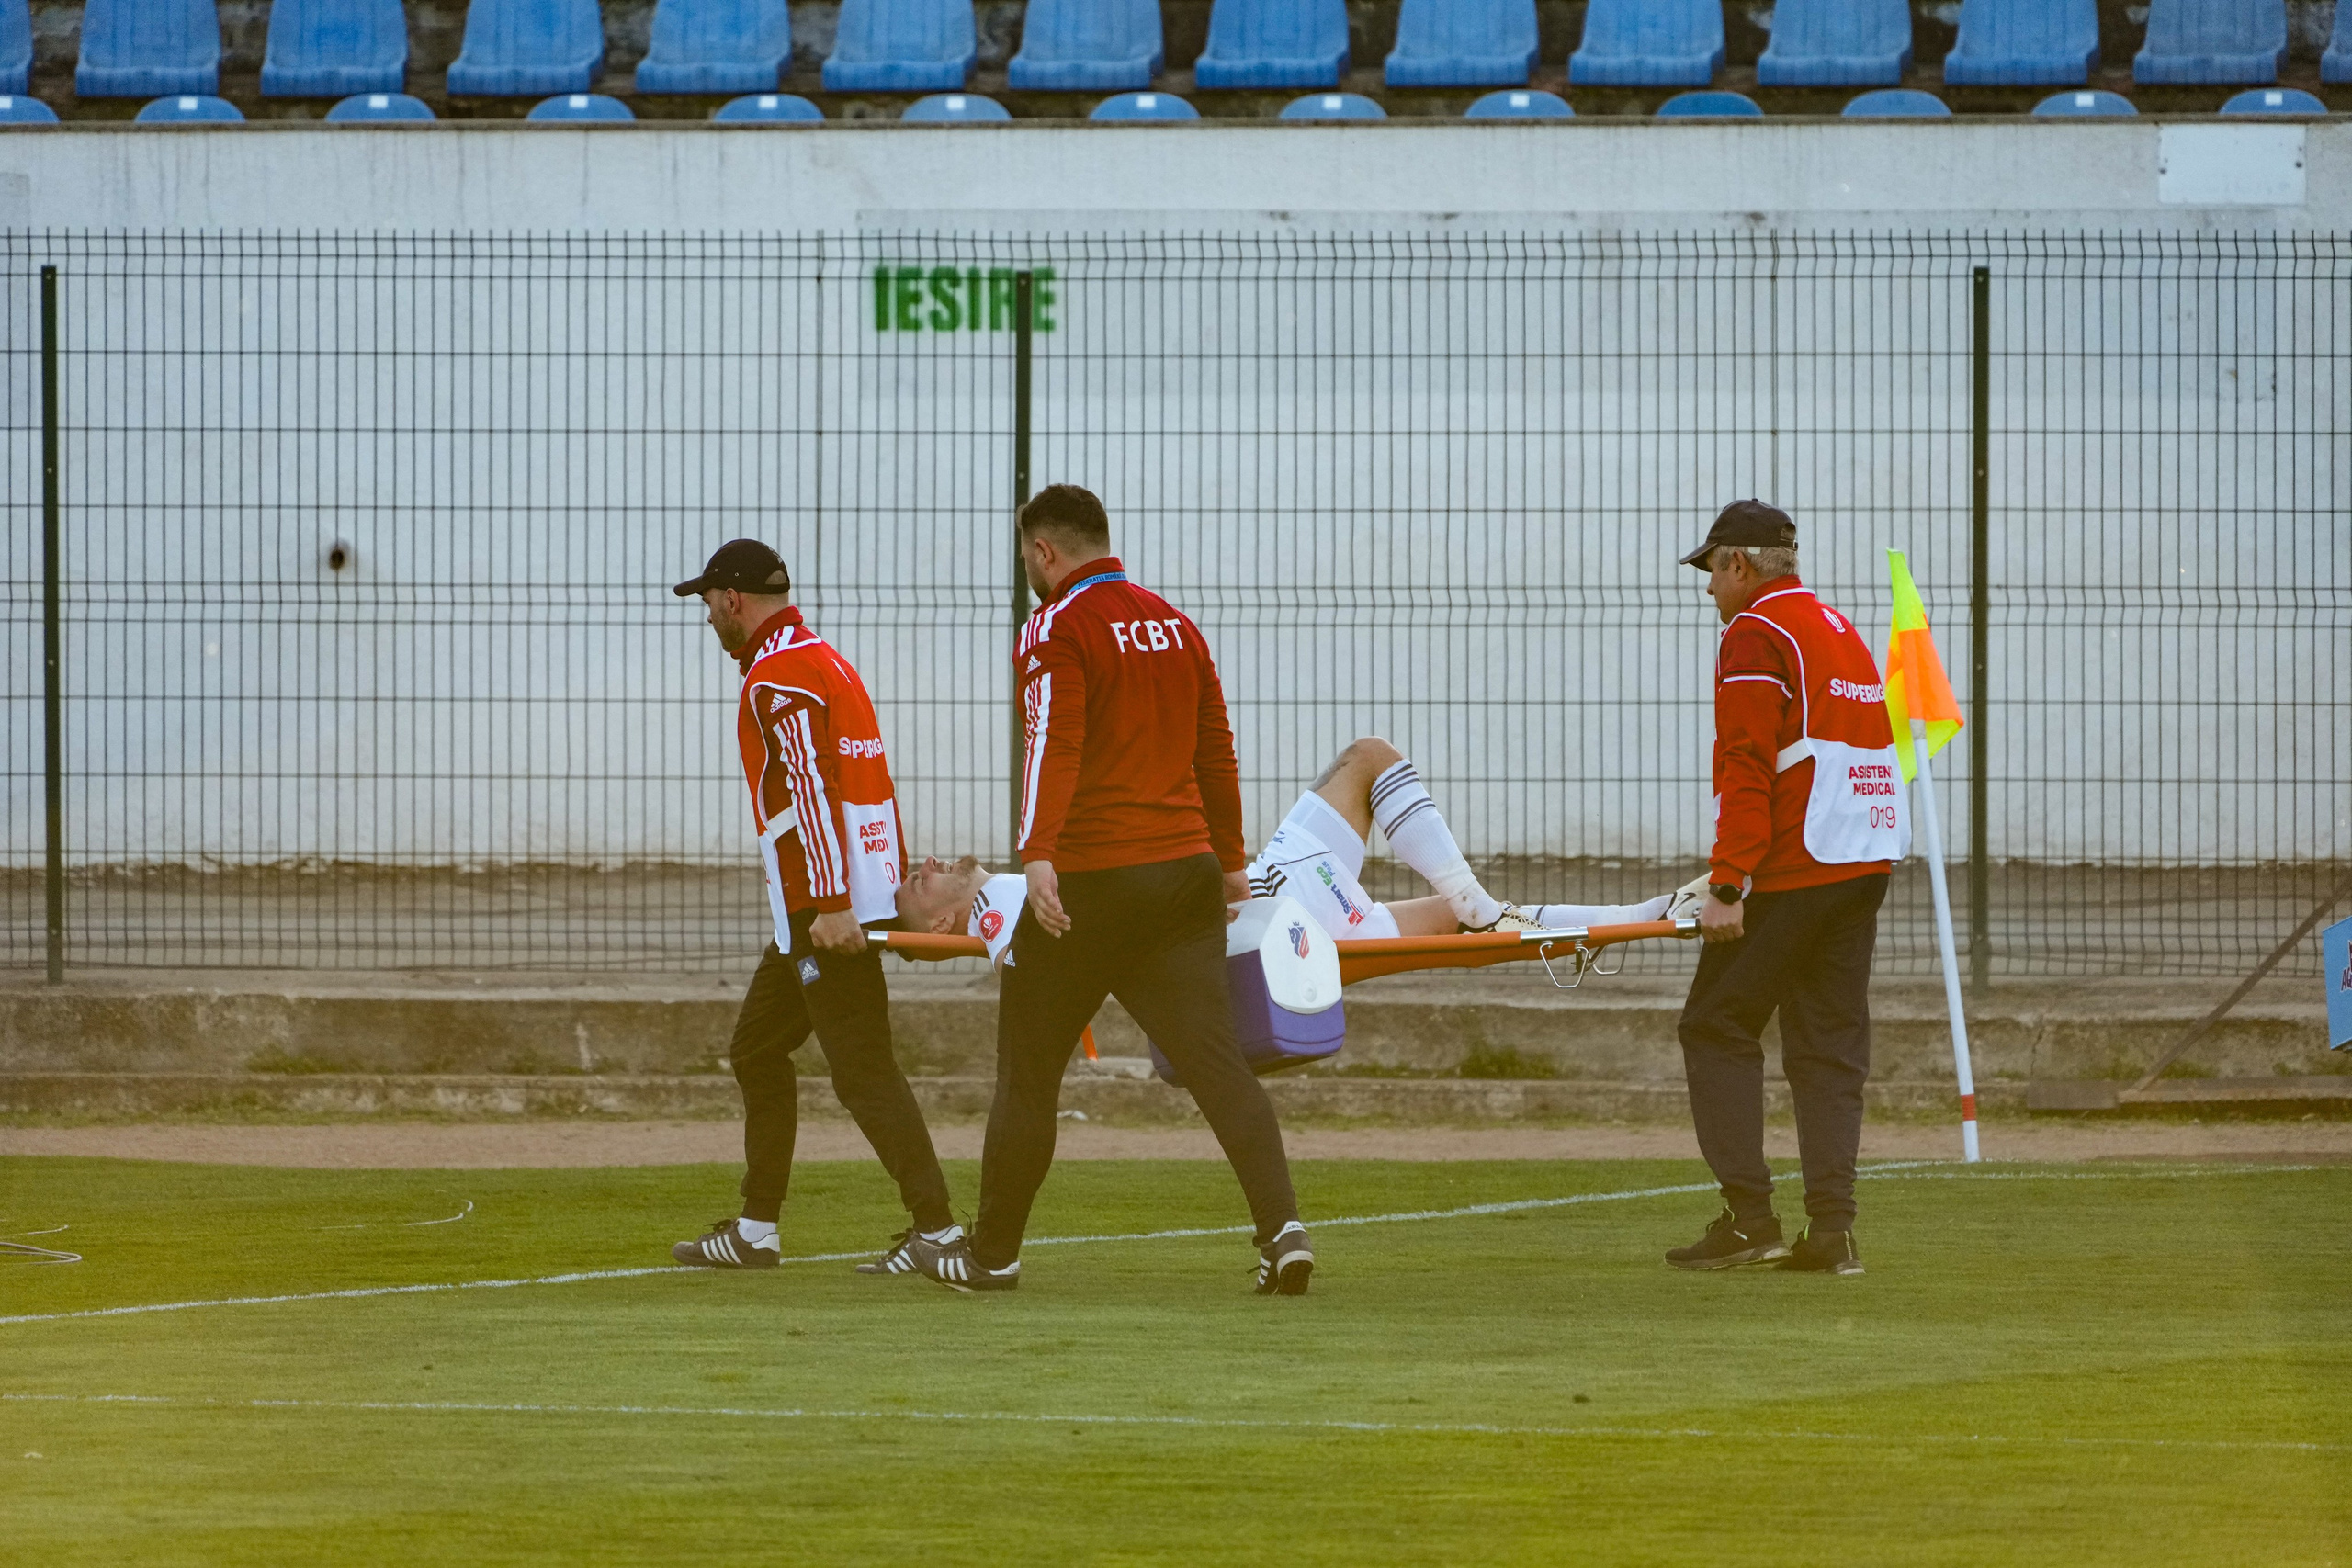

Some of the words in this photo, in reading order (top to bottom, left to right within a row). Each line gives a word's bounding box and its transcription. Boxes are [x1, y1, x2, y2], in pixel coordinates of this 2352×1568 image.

[874, 265, 1057, 332] IESIRE
[1110, 618, 1184, 654] FCBT
[1830, 677, 1885, 703] SUPERLIG
[770, 697, 793, 714] adidas
[1853, 782, 1896, 796] MEDICAL
[1870, 805, 1896, 829] 019
[1316, 866, 1333, 886] Eco
[1330, 884, 1352, 914] Smart
[801, 969, 819, 980] adidas
